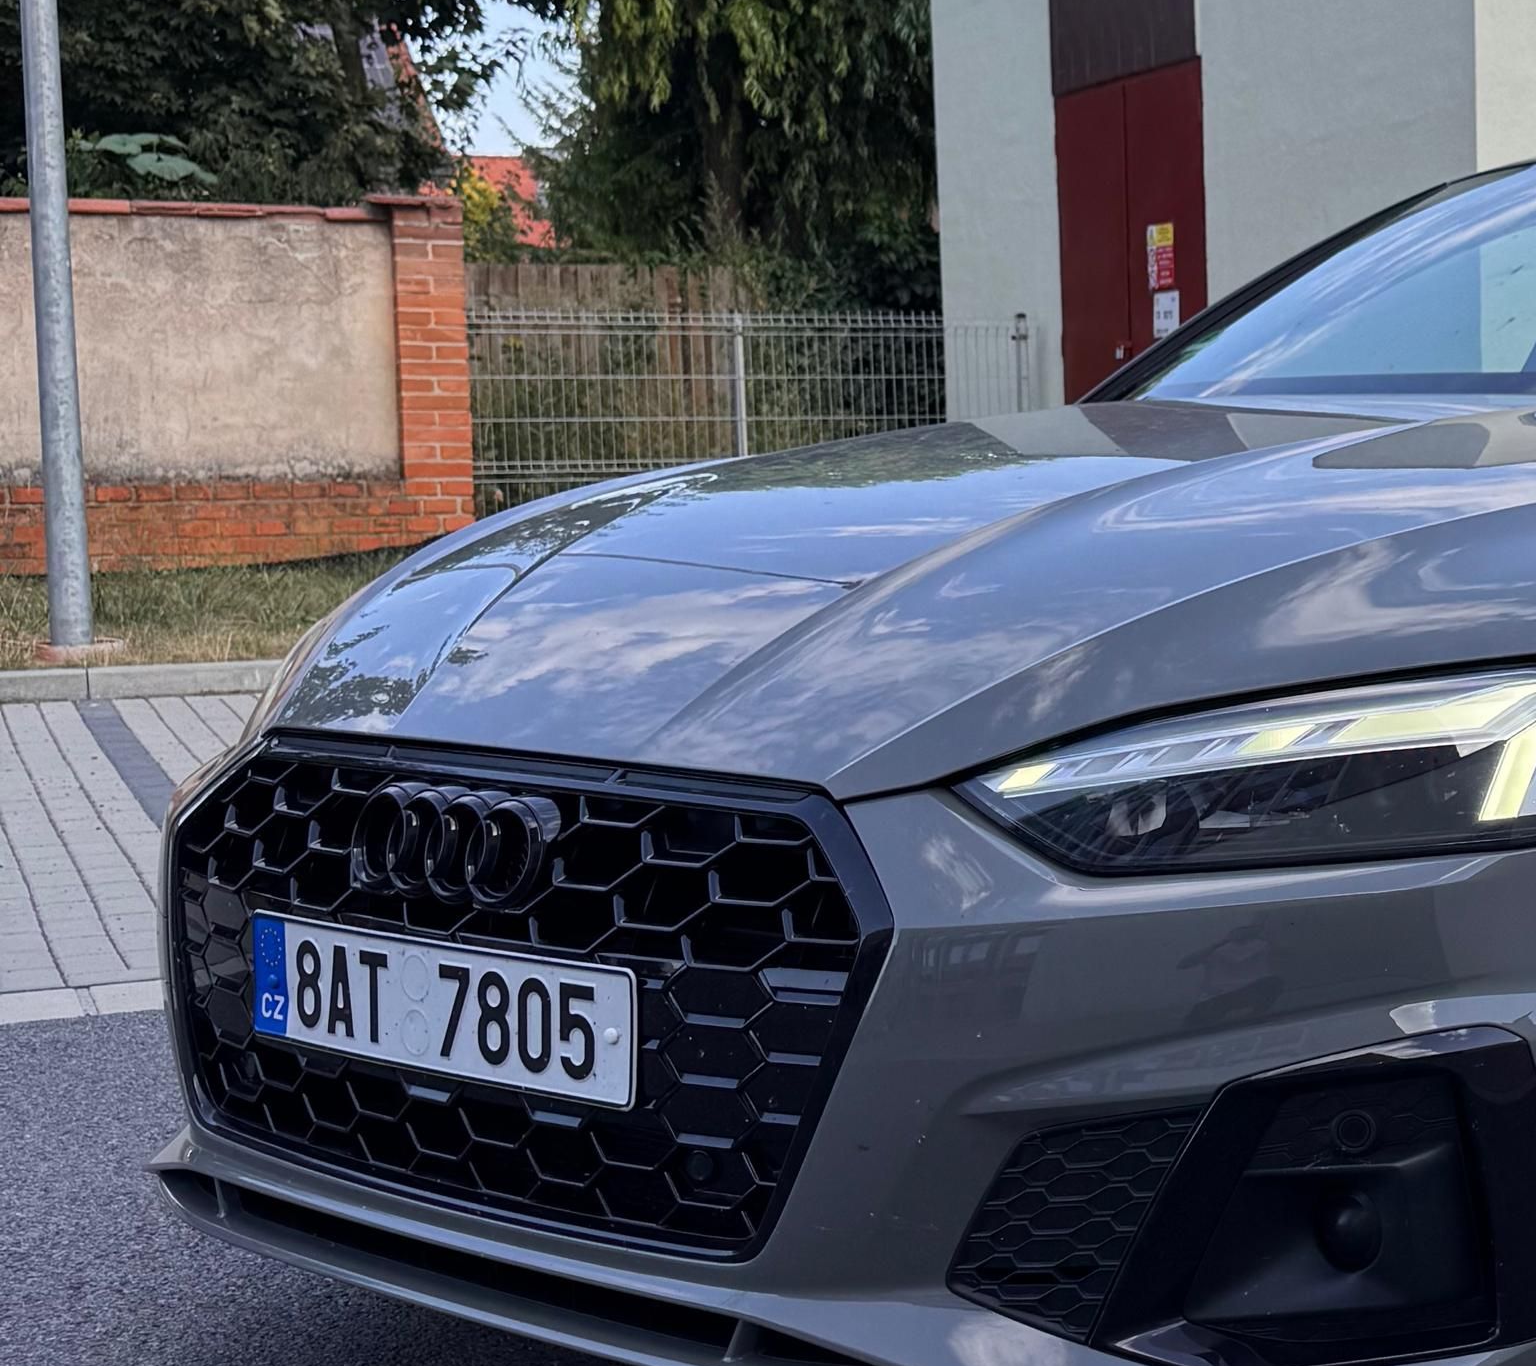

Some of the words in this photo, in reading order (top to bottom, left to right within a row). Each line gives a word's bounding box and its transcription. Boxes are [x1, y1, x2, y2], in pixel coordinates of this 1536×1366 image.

[261, 992, 284, 1021] CZ
[296, 940, 388, 1043] 8AT
[438, 963, 596, 1080] 7805
